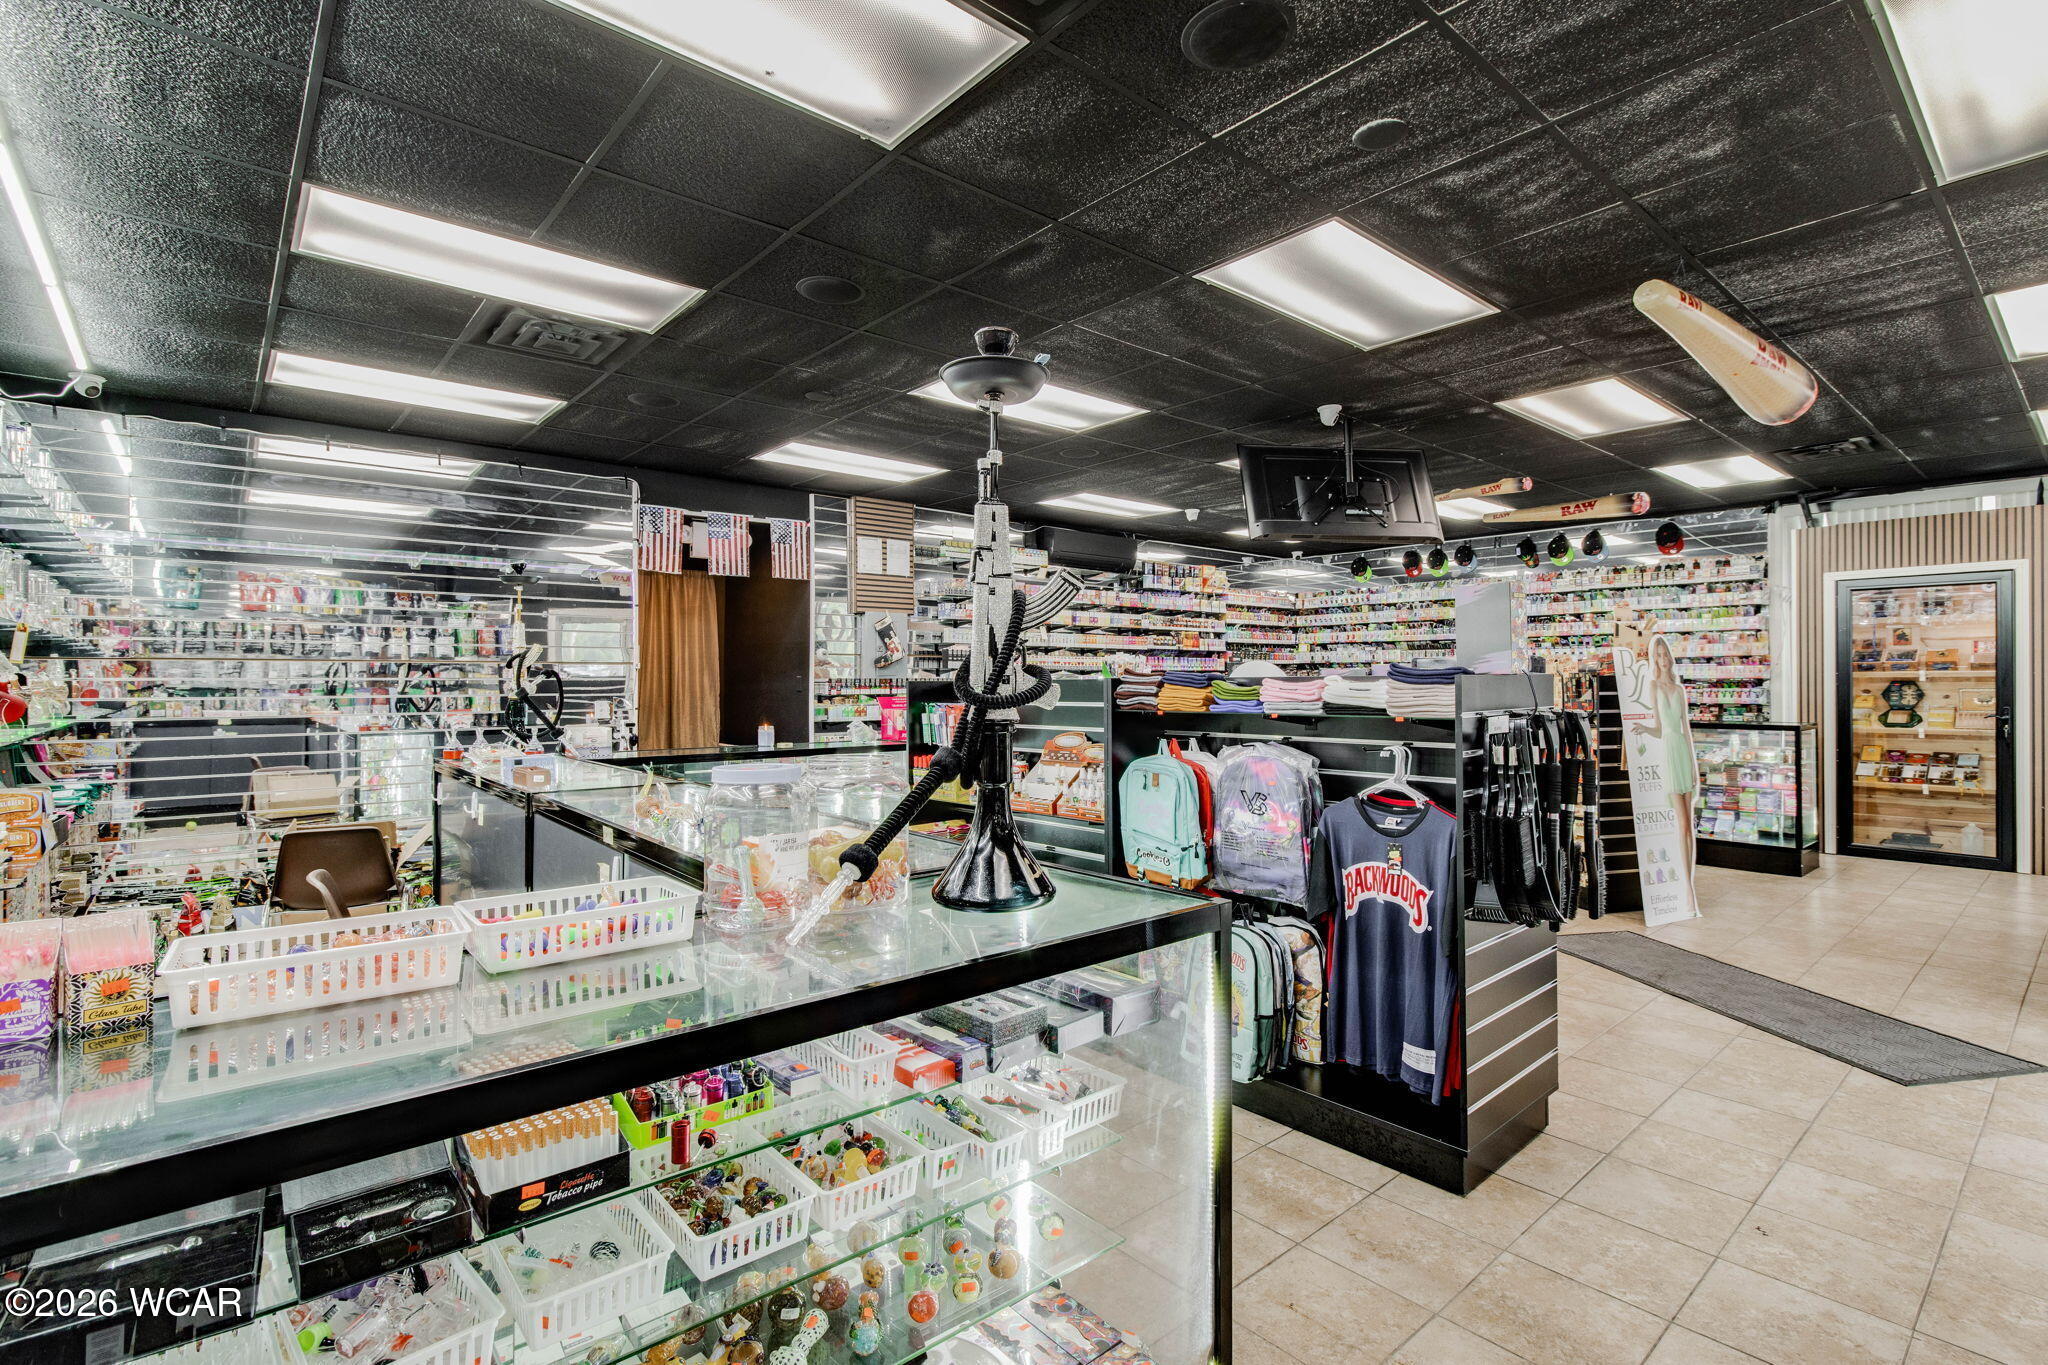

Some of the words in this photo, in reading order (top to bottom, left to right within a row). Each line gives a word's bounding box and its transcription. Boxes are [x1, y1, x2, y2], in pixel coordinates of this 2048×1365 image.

[1480, 484, 1502, 495] RAW
[1493, 512, 1511, 520] RAW
[1560, 500, 1598, 517] RAW
[1637, 765, 1661, 782] 35K
[1638, 782, 1663, 793] PUFFS
[1635, 809, 1675, 825] SPRING
[1345, 865, 1428, 927] BACKWOODS
[88, 1010, 118, 1021] Glass
[121, 1003, 145, 1015] Tube
[559, 1171, 596, 1190] Cigarette
[543, 1186, 583, 1206] Tobacco
[583, 1178, 604, 1193] pipe
